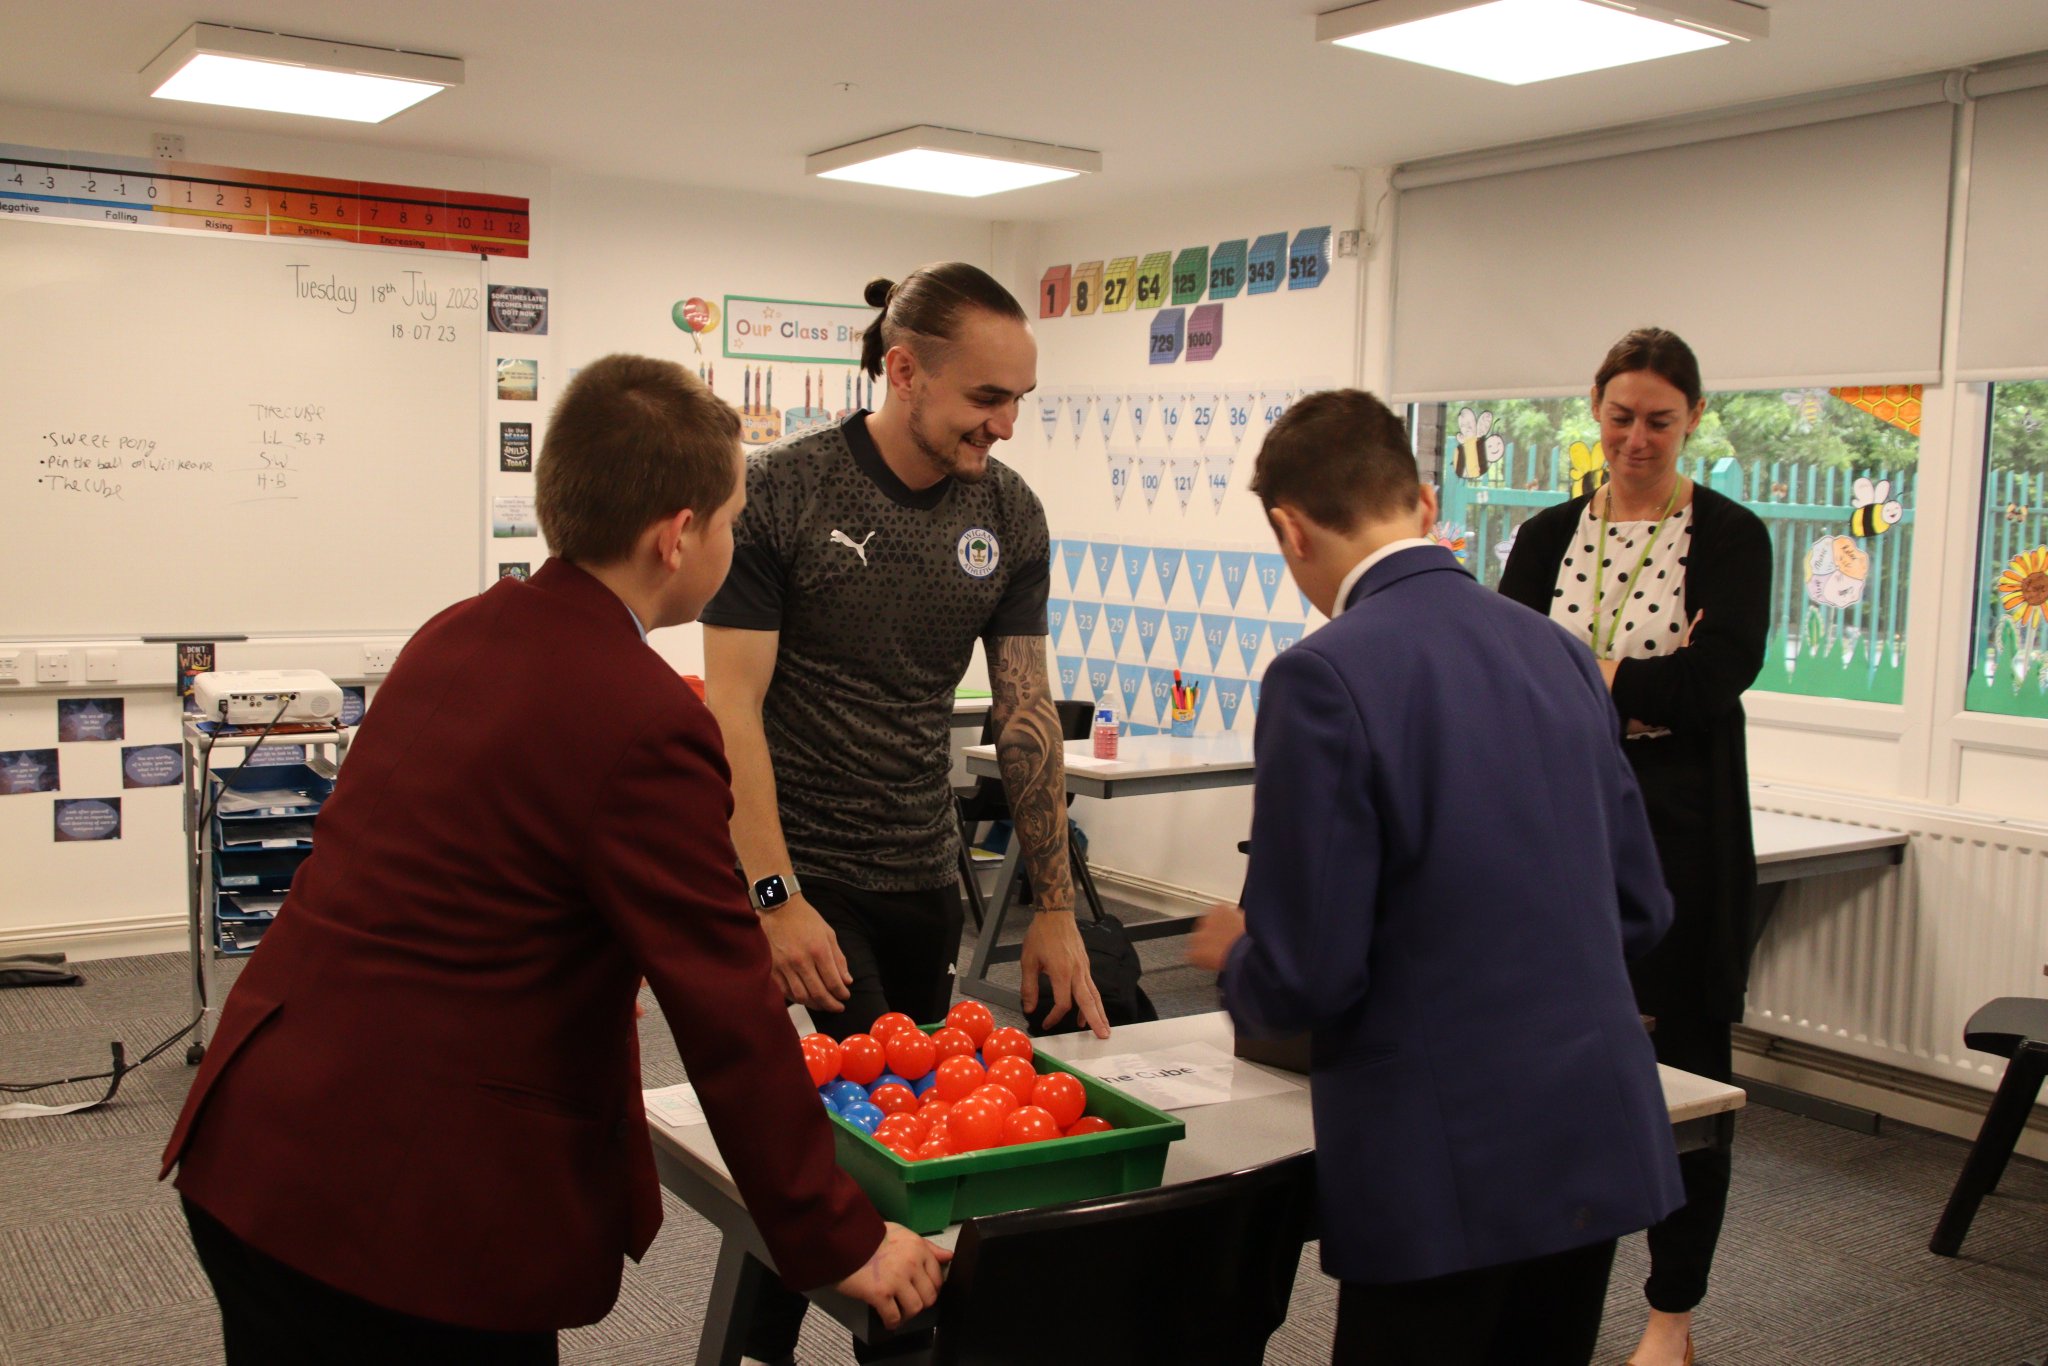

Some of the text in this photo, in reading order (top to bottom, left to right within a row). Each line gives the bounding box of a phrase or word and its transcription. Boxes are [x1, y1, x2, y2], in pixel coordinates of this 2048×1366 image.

[7, 173, 521, 233] -4 -3 -2 -1 0 1 2 3 4 5 6 7 8 9 10 11 12
[0, 202, 505, 254] egative Falling Rising Positive Increasing Warmer
[285, 264, 479, 321] Tuesday 18th July 2023
[1046, 255, 1317, 314] 1 8 27 64 125 216 343 512
[491, 293, 527, 301] SOMETIMES
[736, 319, 773, 337] Our
[780, 320, 828, 341] Class
[1150, 332, 1213, 354] 729 1000
[1075, 408, 1081, 425] 1
[1103, 408, 1110, 425] 4
[1134, 408, 1143, 425] 9
[1163, 408, 1177, 425] 16
[1194, 407, 1211, 425] 25
[1230, 407, 1247, 425] 36
[506, 458, 527, 467] TODAY
[1111, 468, 1227, 491] 81 100 121 144
[964, 530, 993, 542] WIGAN
[964, 563, 992, 576] ATHLETIC
[1100, 557, 1276, 585] 2 3 5 7 11 13
[1050, 612, 1294, 652] 19 23 29 31 37 41 43 47
[179, 653, 212, 669] WISH
[1062, 670, 1236, 709] 53 59 61 67 73
[1098, 1066, 1196, 1084] he Cube
